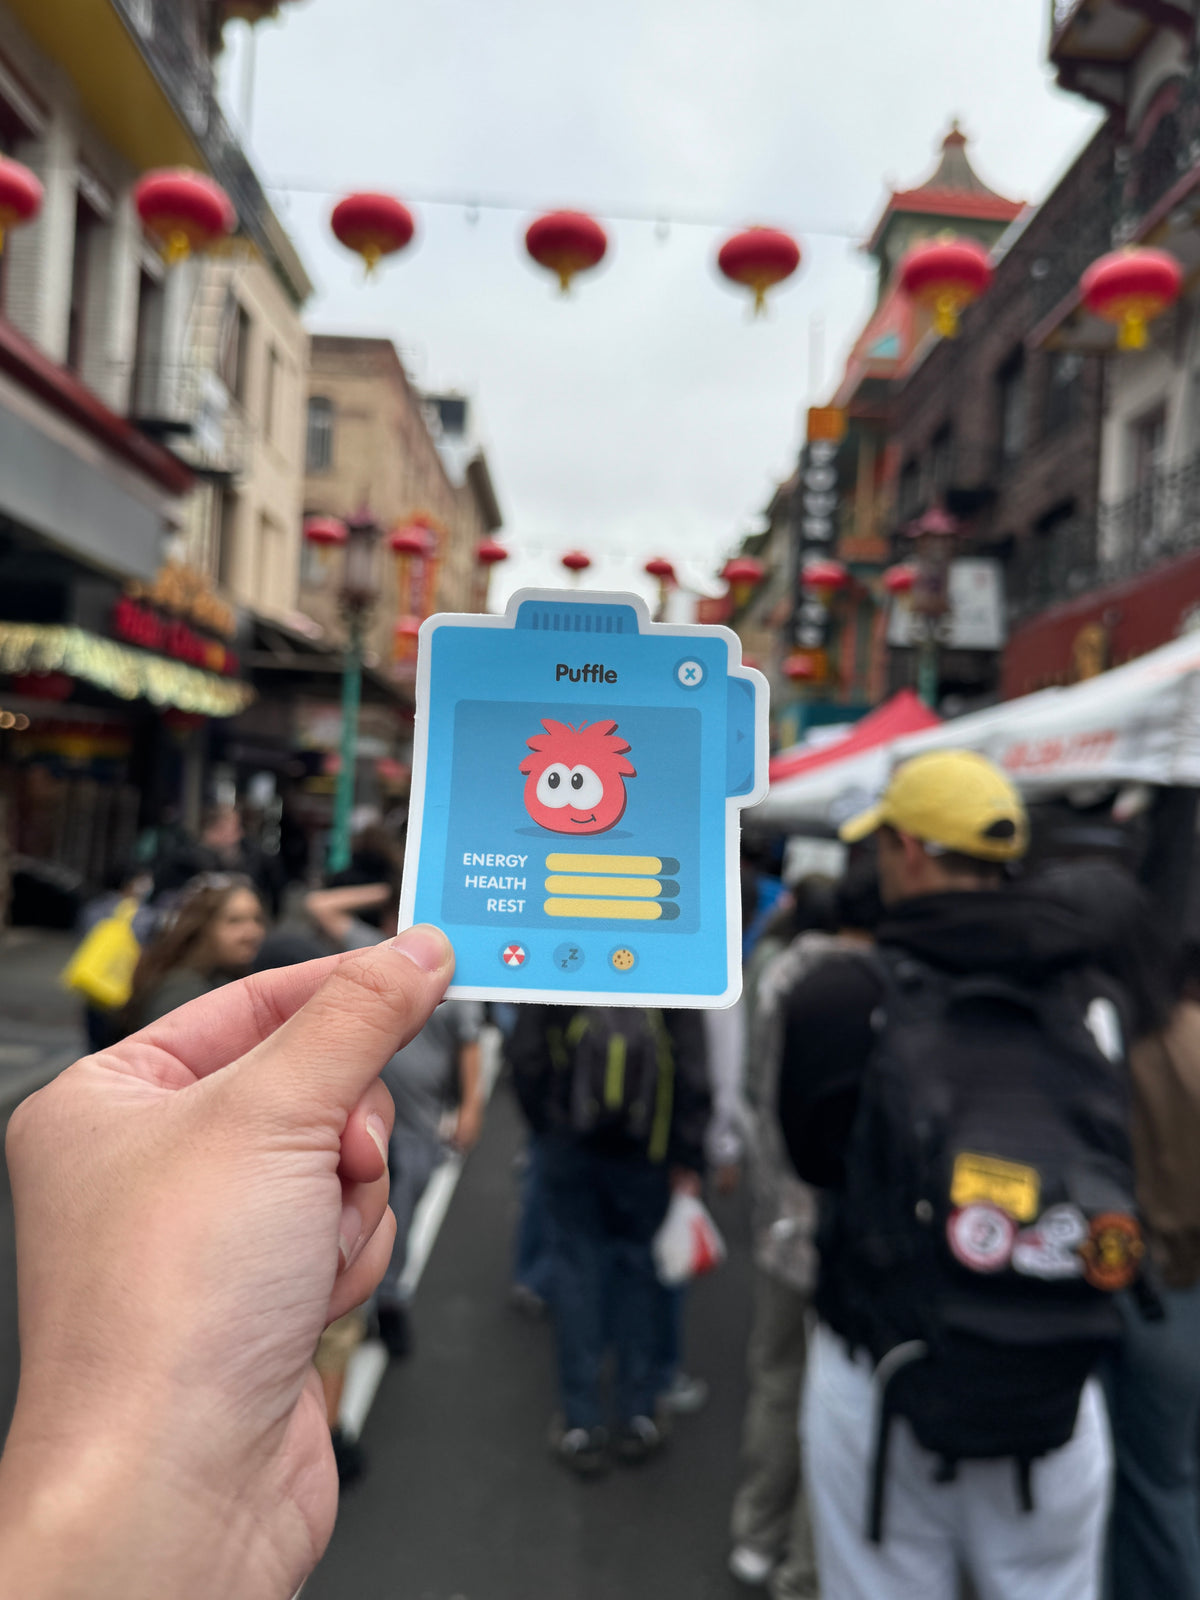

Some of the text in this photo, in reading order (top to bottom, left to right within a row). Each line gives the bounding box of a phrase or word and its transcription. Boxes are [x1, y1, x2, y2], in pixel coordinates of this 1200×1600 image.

[556, 663, 618, 684] Puffle
[463, 852, 529, 868] ENERGY
[465, 875, 527, 891] HEALTH
[487, 898, 527, 913] REST
